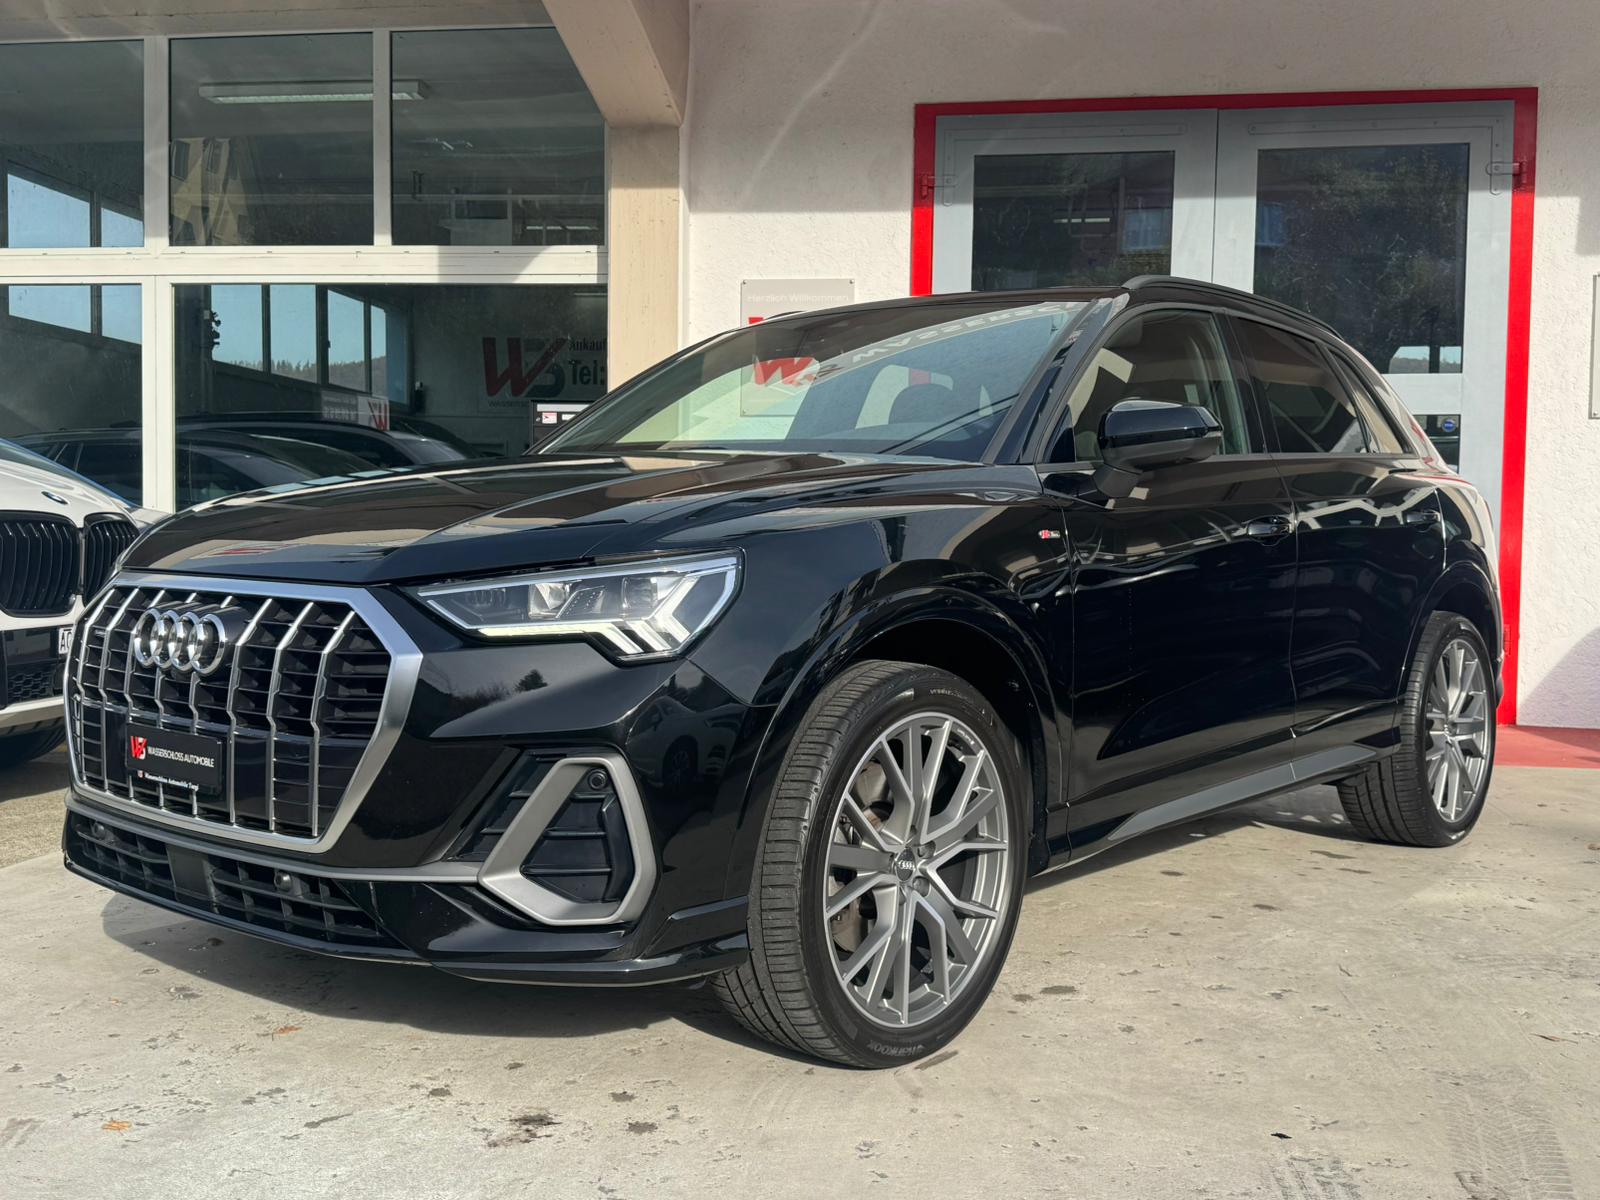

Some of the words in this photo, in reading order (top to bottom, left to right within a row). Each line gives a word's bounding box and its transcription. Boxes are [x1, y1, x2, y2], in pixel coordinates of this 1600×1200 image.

[789, 293, 849, 303] Willkommen
[147, 746, 184, 762] WASSERSCHLOSS
[183, 754, 215, 768] AUTOMOBILE
